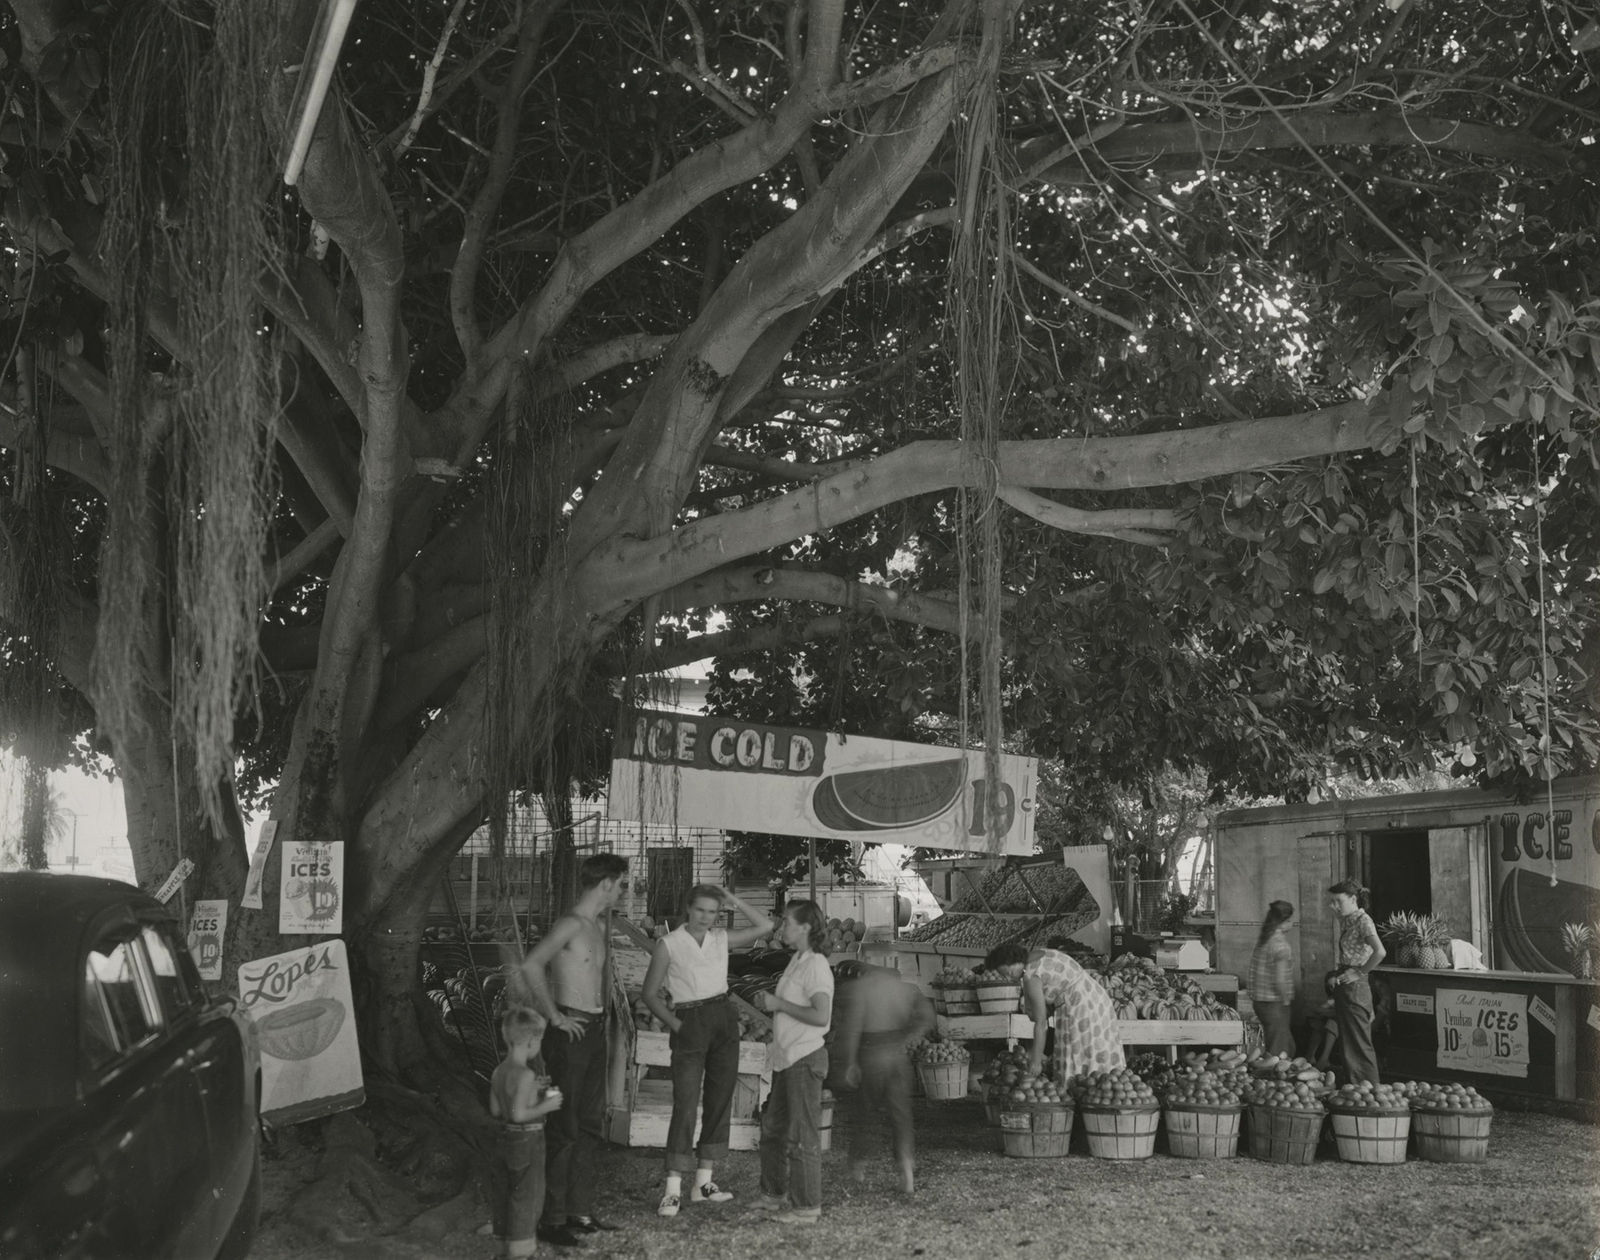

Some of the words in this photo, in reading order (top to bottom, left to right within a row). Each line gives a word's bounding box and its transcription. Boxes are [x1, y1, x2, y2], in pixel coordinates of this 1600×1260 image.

[633, 716, 697, 761] ICE
[711, 727, 814, 772] COLD
[1500, 809, 1573, 861] ICE
[290, 862, 331, 878] ICES
[315, 891, 334, 908] 10
[192, 919, 218, 932] ICES
[203, 944, 216, 957] 10
[243, 947, 339, 1006] Lopes
[1477, 1009, 1519, 1031] ICES
